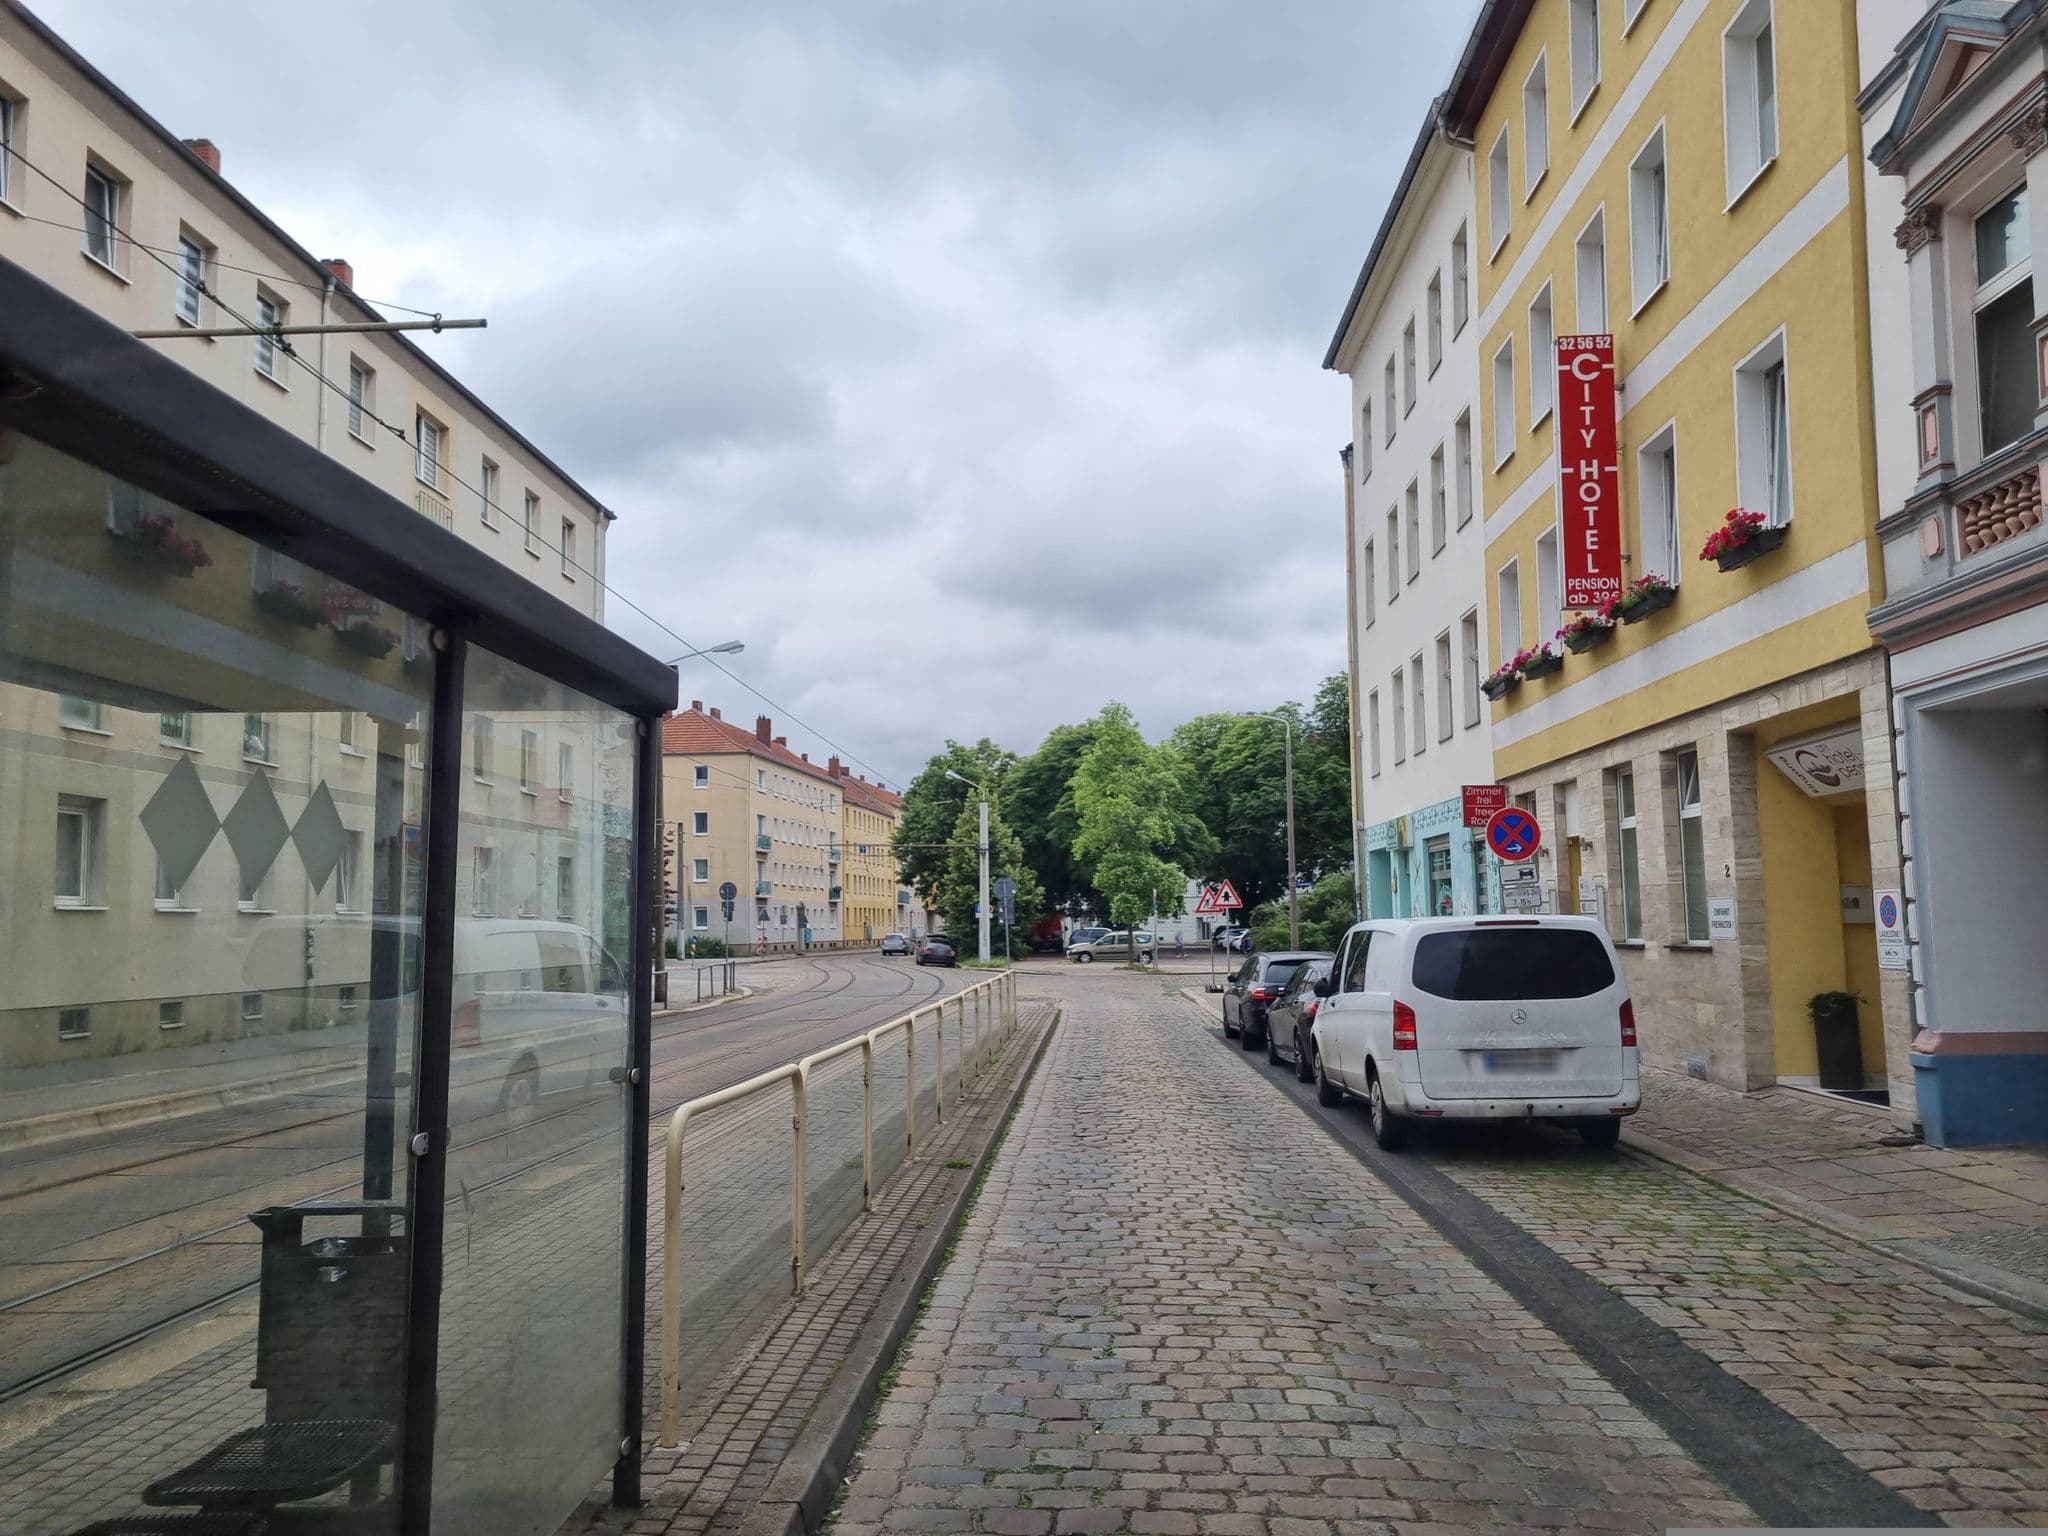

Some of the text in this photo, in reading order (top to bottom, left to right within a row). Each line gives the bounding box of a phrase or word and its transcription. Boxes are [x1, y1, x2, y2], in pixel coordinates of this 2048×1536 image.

[1559, 335, 1611, 350] 32 56 52
[1571, 353, 1601, 449] CITY
[1578, 459, 1601, 574] HOTEL
[1568, 577, 1620, 590] PENSION
[1568, 592, 1589, 604] ab
[1465, 787, 1502, 796] Zimmer
[1476, 796, 1492, 804] frei
[1475, 807, 1495, 816] free
[1470, 816, 1489, 825] Roo
[1724, 864, 1731, 878] 2
